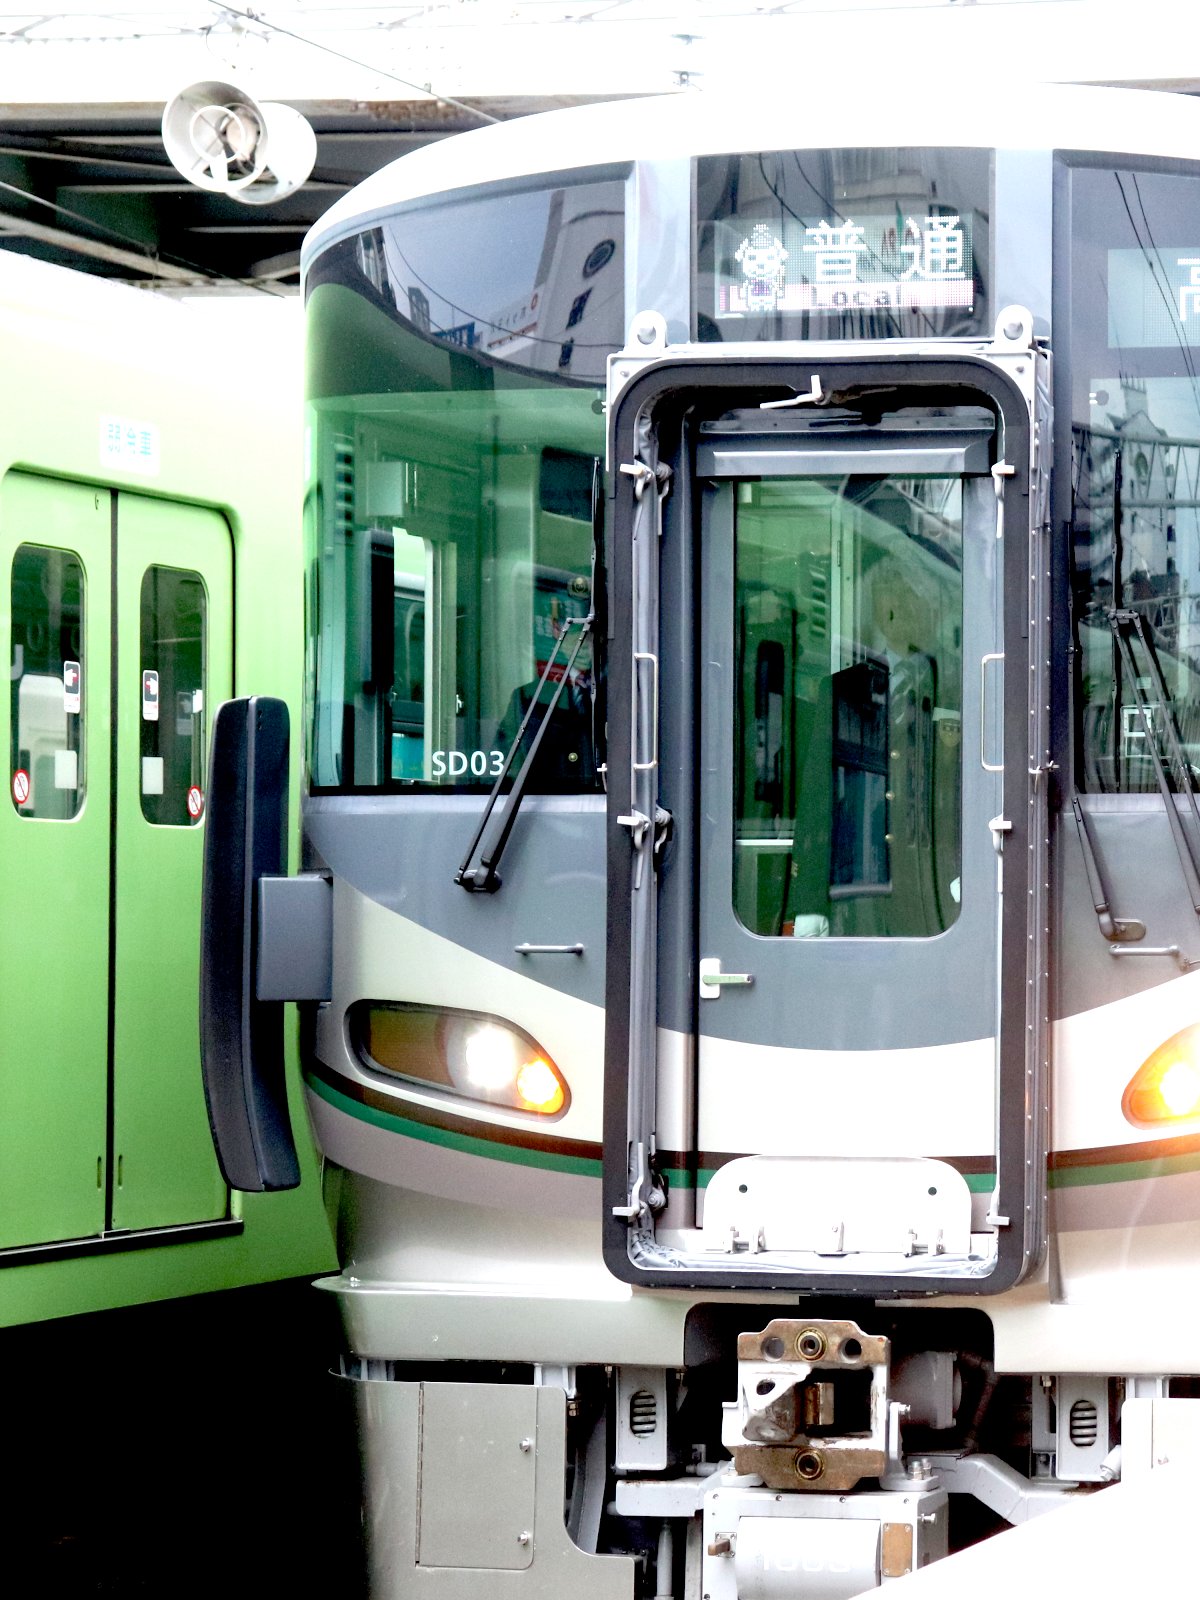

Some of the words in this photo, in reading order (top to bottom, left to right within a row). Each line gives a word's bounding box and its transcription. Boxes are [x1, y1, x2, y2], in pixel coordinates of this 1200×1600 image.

[802, 215, 966, 283] 普通
[811, 284, 902, 307] Local
[432, 750, 505, 776] SD03
